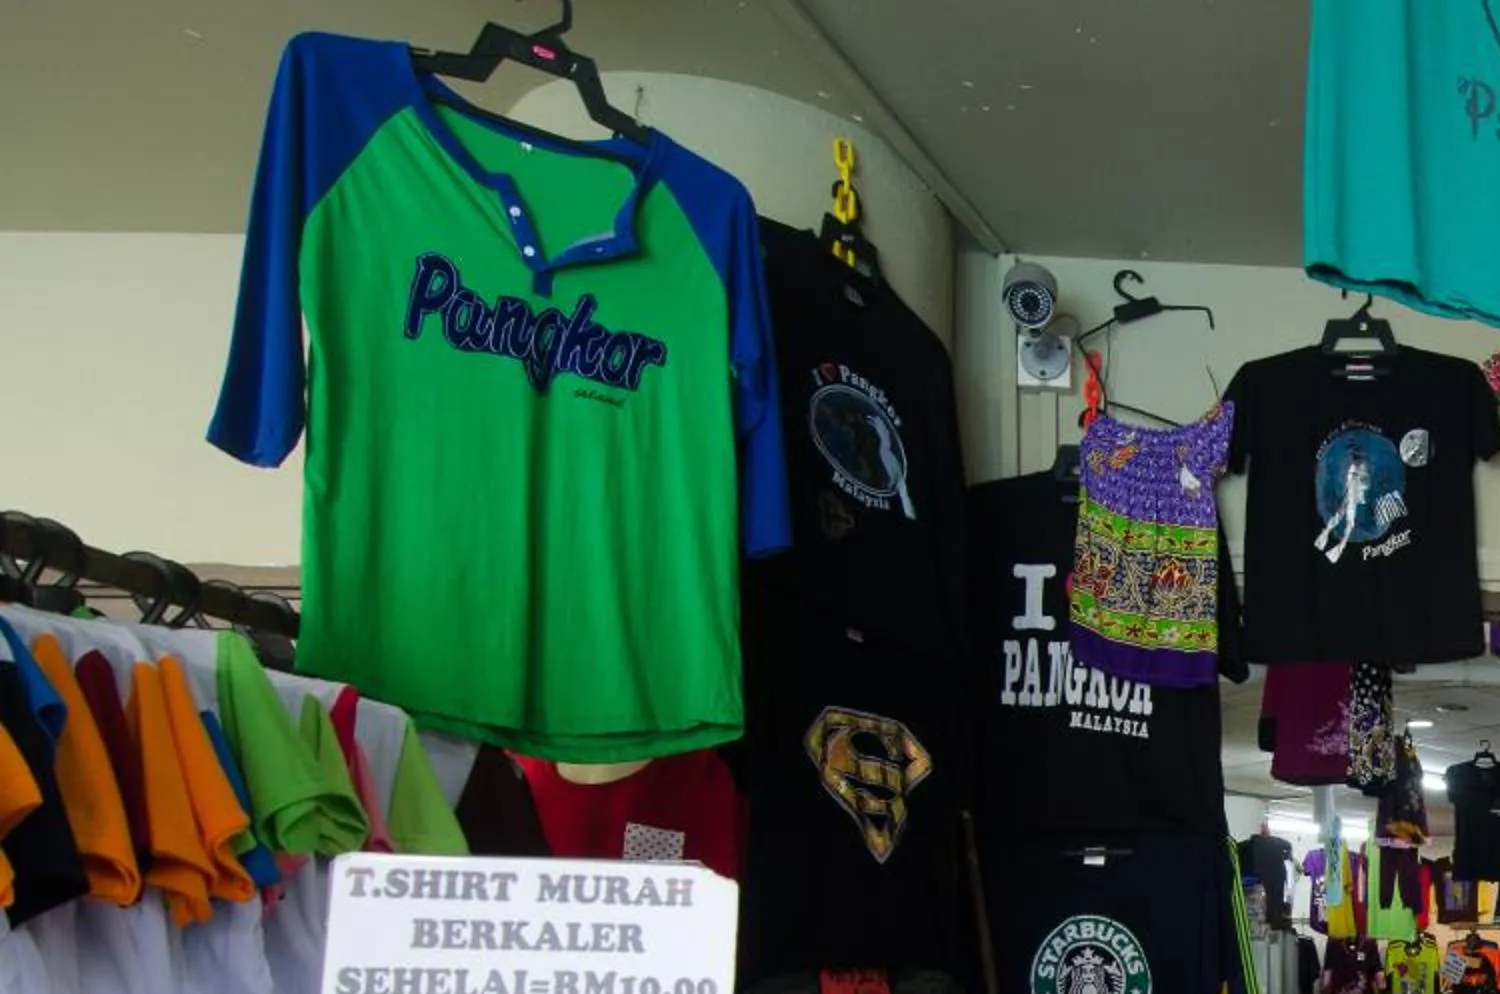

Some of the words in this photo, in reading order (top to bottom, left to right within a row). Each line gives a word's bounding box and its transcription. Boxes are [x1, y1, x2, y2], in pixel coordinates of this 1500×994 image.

[404, 252, 667, 392] Pangkor
[1012, 563, 1057, 631] I
[1069, 710, 1149, 738] MALAYSIA
[346, 868, 517, 902] T.SHIRT
[537, 874, 694, 907] MURAH
[410, 918, 645, 954] BERKALER
[1038, 921, 1145, 980] STARBUCKS
